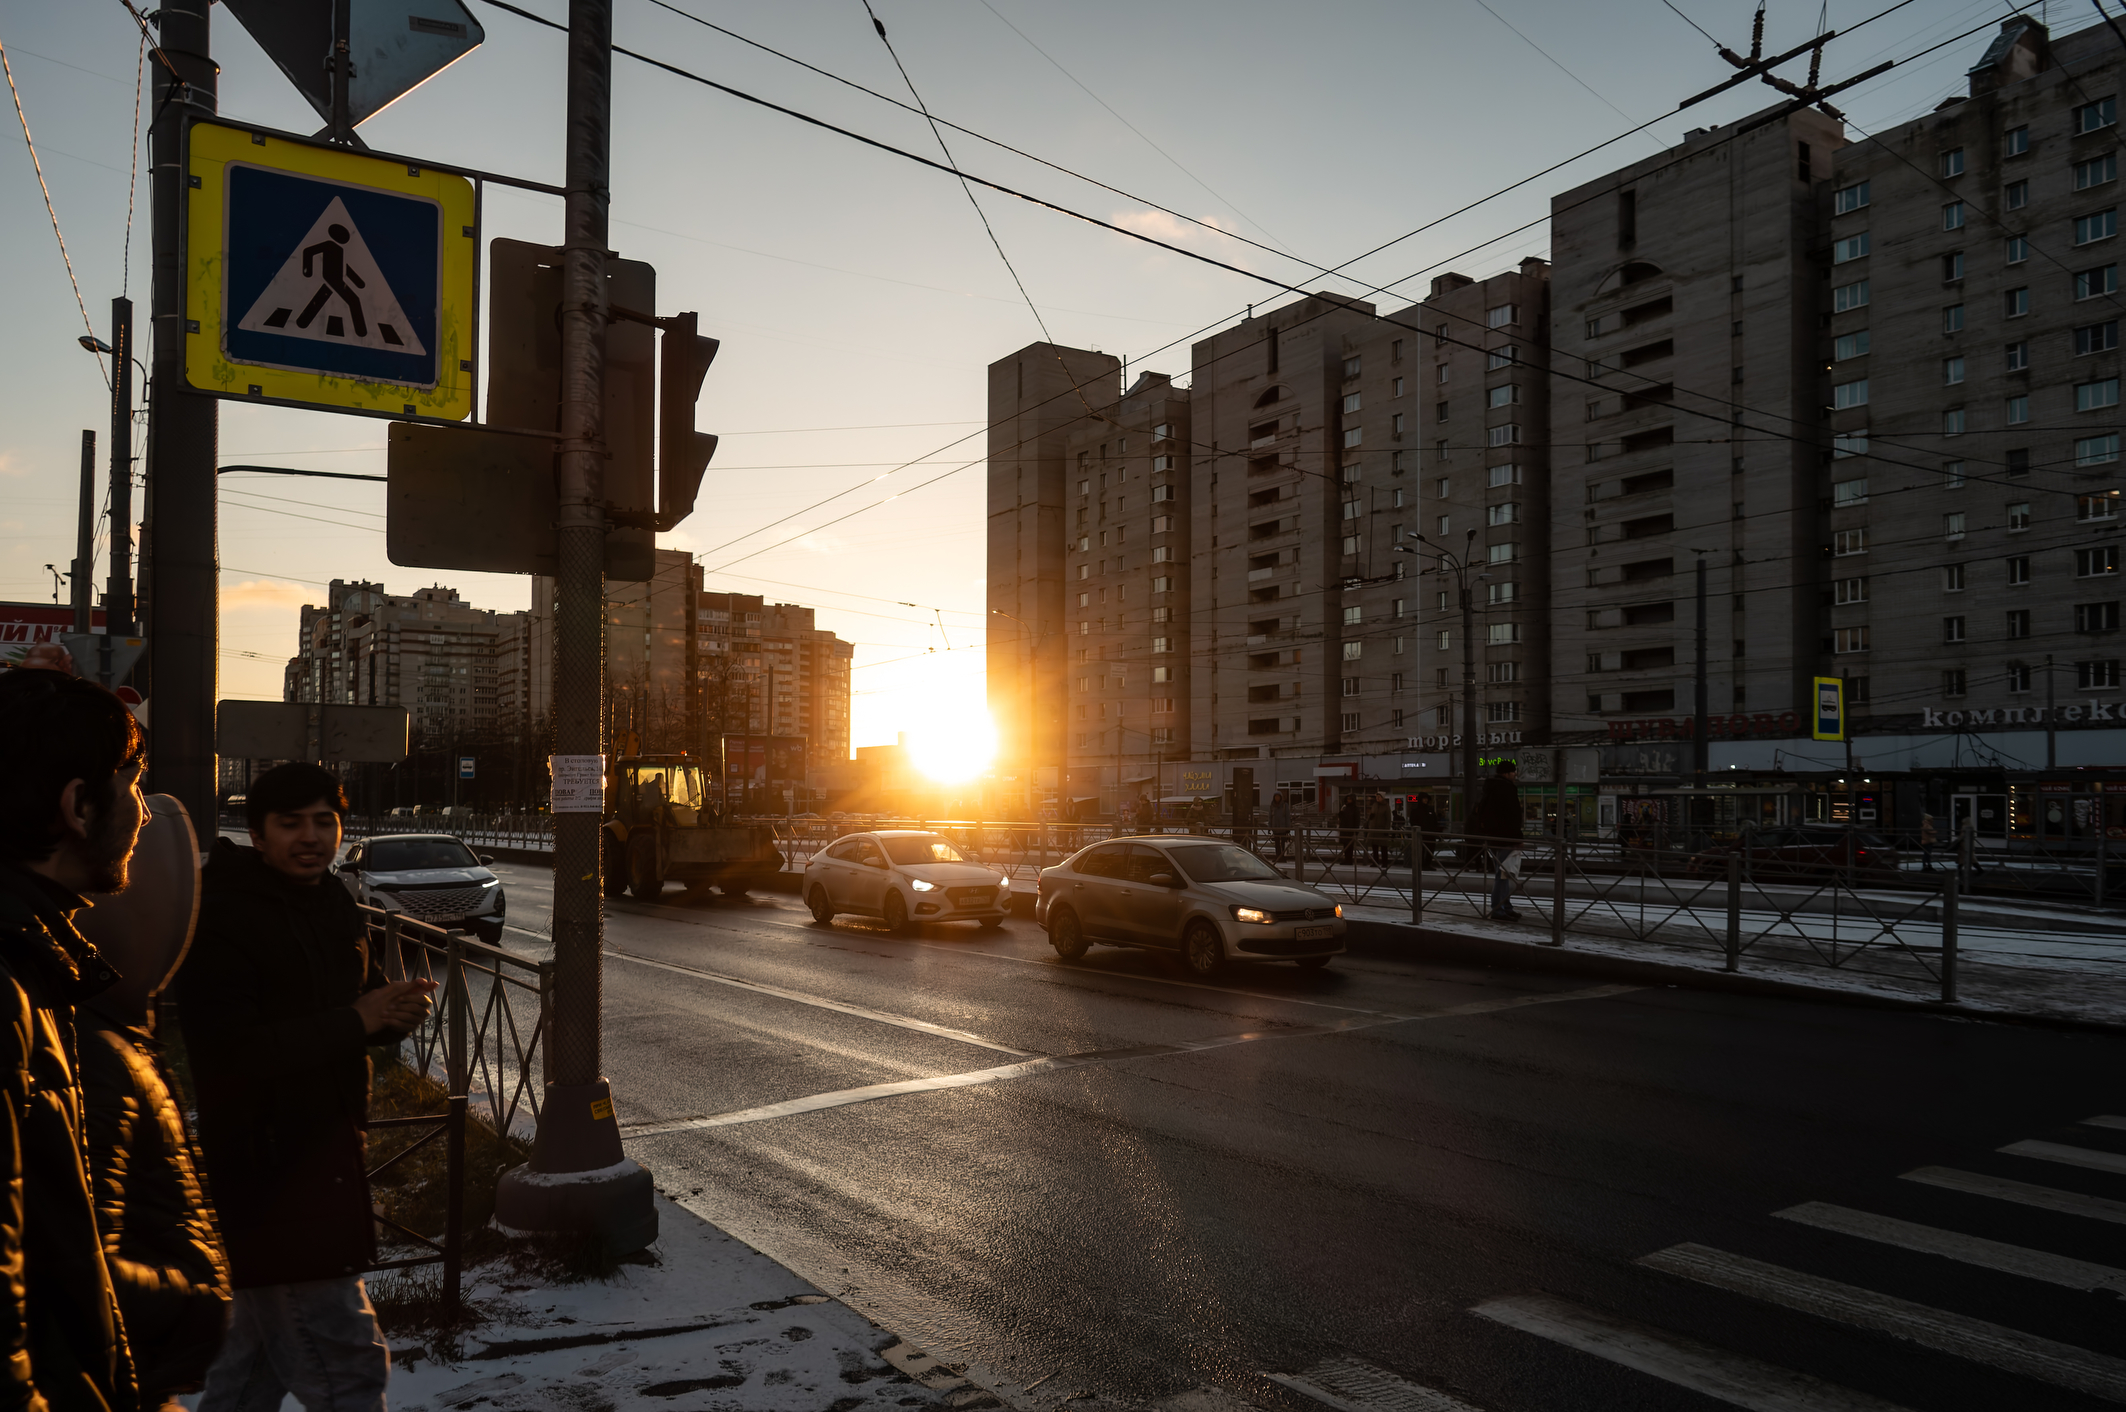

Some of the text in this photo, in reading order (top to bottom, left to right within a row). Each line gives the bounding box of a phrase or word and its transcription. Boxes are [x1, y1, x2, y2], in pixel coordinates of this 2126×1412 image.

[1607, 711, 1801, 739] ШУВАЛОВО
[790, 744, 802, 752] wb
[1407, 731, 1522, 750] торгвый
